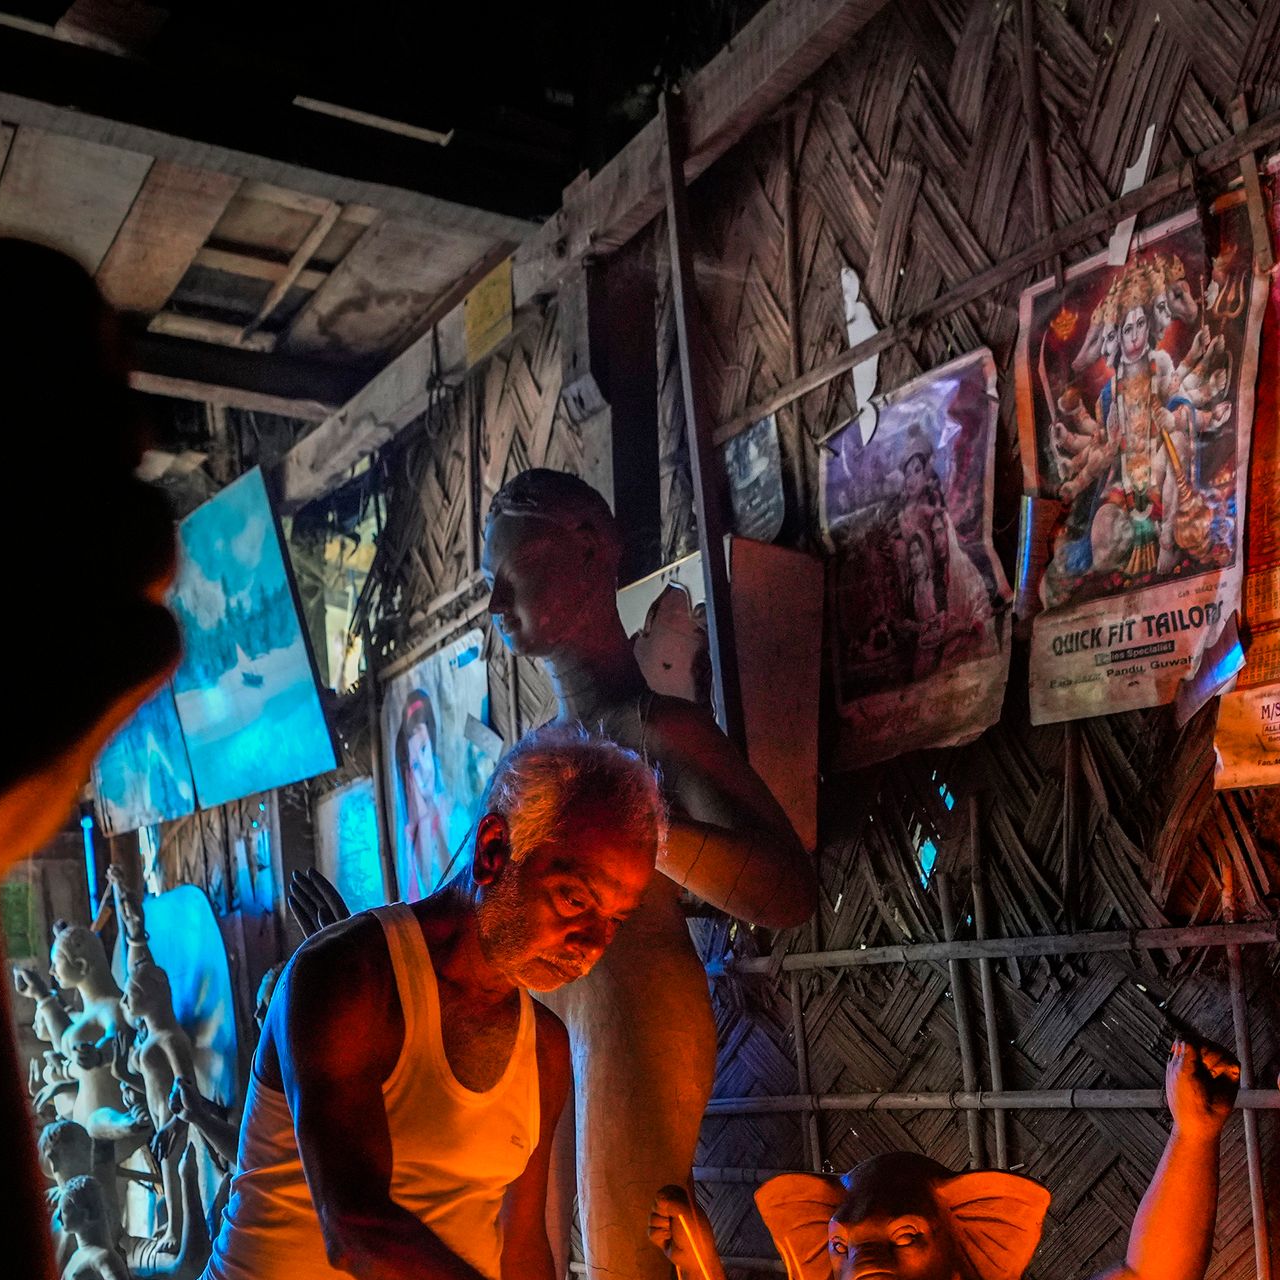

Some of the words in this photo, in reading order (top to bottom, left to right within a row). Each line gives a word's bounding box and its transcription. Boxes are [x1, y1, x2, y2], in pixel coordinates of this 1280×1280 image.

[1052, 627, 1103, 656] QUICK
[1107, 619, 1136, 647] FIT
[1126, 642, 1173, 659] Specialist
[1264, 722, 1278, 733] ALL
